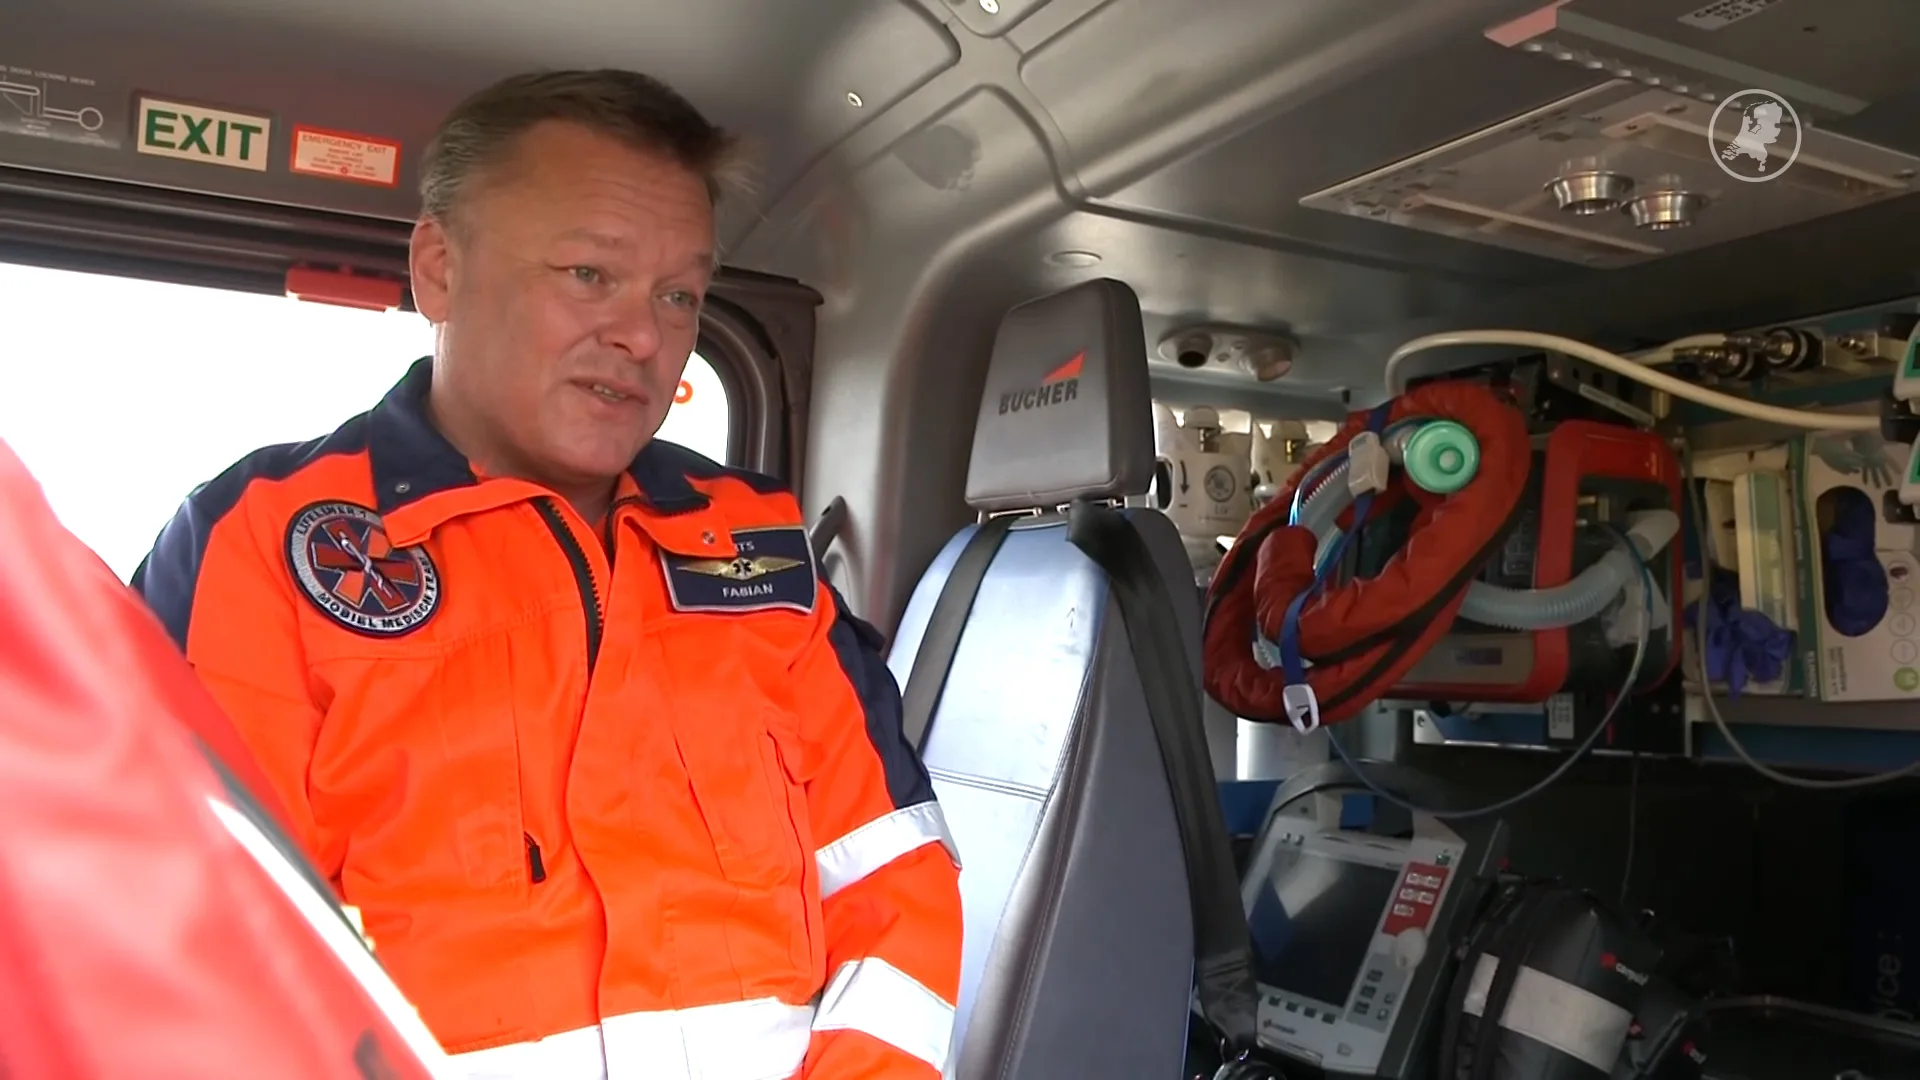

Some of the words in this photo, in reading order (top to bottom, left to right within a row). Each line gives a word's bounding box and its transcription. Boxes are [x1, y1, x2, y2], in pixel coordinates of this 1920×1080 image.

[145, 108, 263, 161] EXIT
[302, 134, 363, 150] EMERGENCY
[366, 143, 388, 154] EXIT
[999, 378, 1079, 416] BUCHER
[722, 583, 774, 598] FABIAN
[317, 592, 378, 629] MOBIEL
[381, 593, 434, 629] MEDISCH
